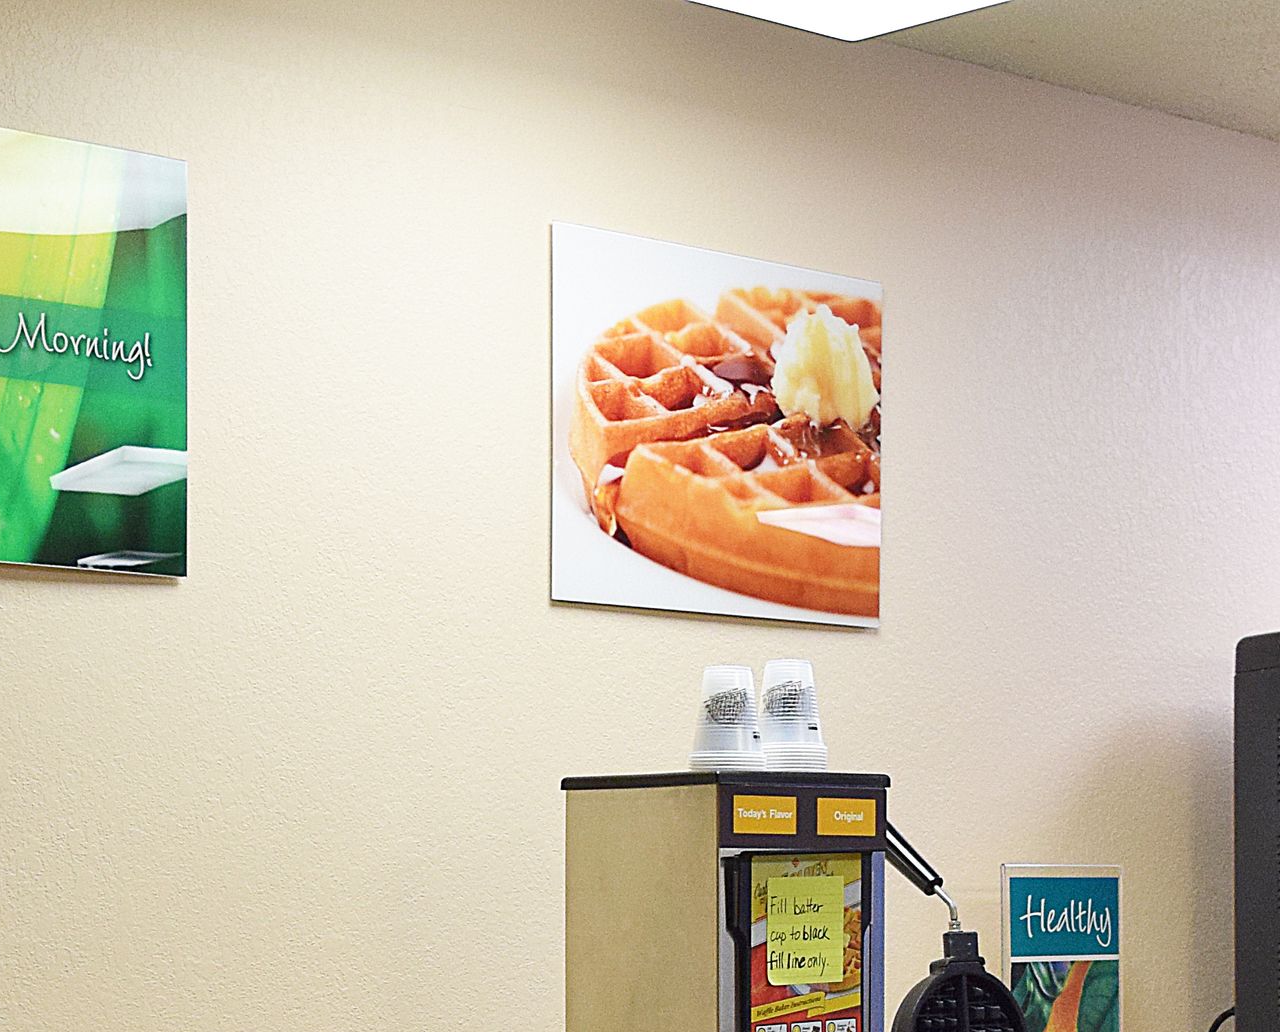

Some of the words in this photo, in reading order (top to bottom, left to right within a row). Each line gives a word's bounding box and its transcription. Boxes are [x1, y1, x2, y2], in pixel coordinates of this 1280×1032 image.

[737, 808, 767, 820] Today's
[770, 808, 793, 819] Flavor
[834, 810, 864, 823] Original
[770, 896, 787, 915] Fill
[793, 897, 823, 916] batter
[1019, 894, 1112, 947] Healthy
[770, 929, 787, 946] cup
[790, 927, 801, 941] to
[802, 925, 830, 941] black
[768, 950, 784, 971] fill
[786, 951, 806, 969] line
[756, 1006, 774, 1018] Waffle
